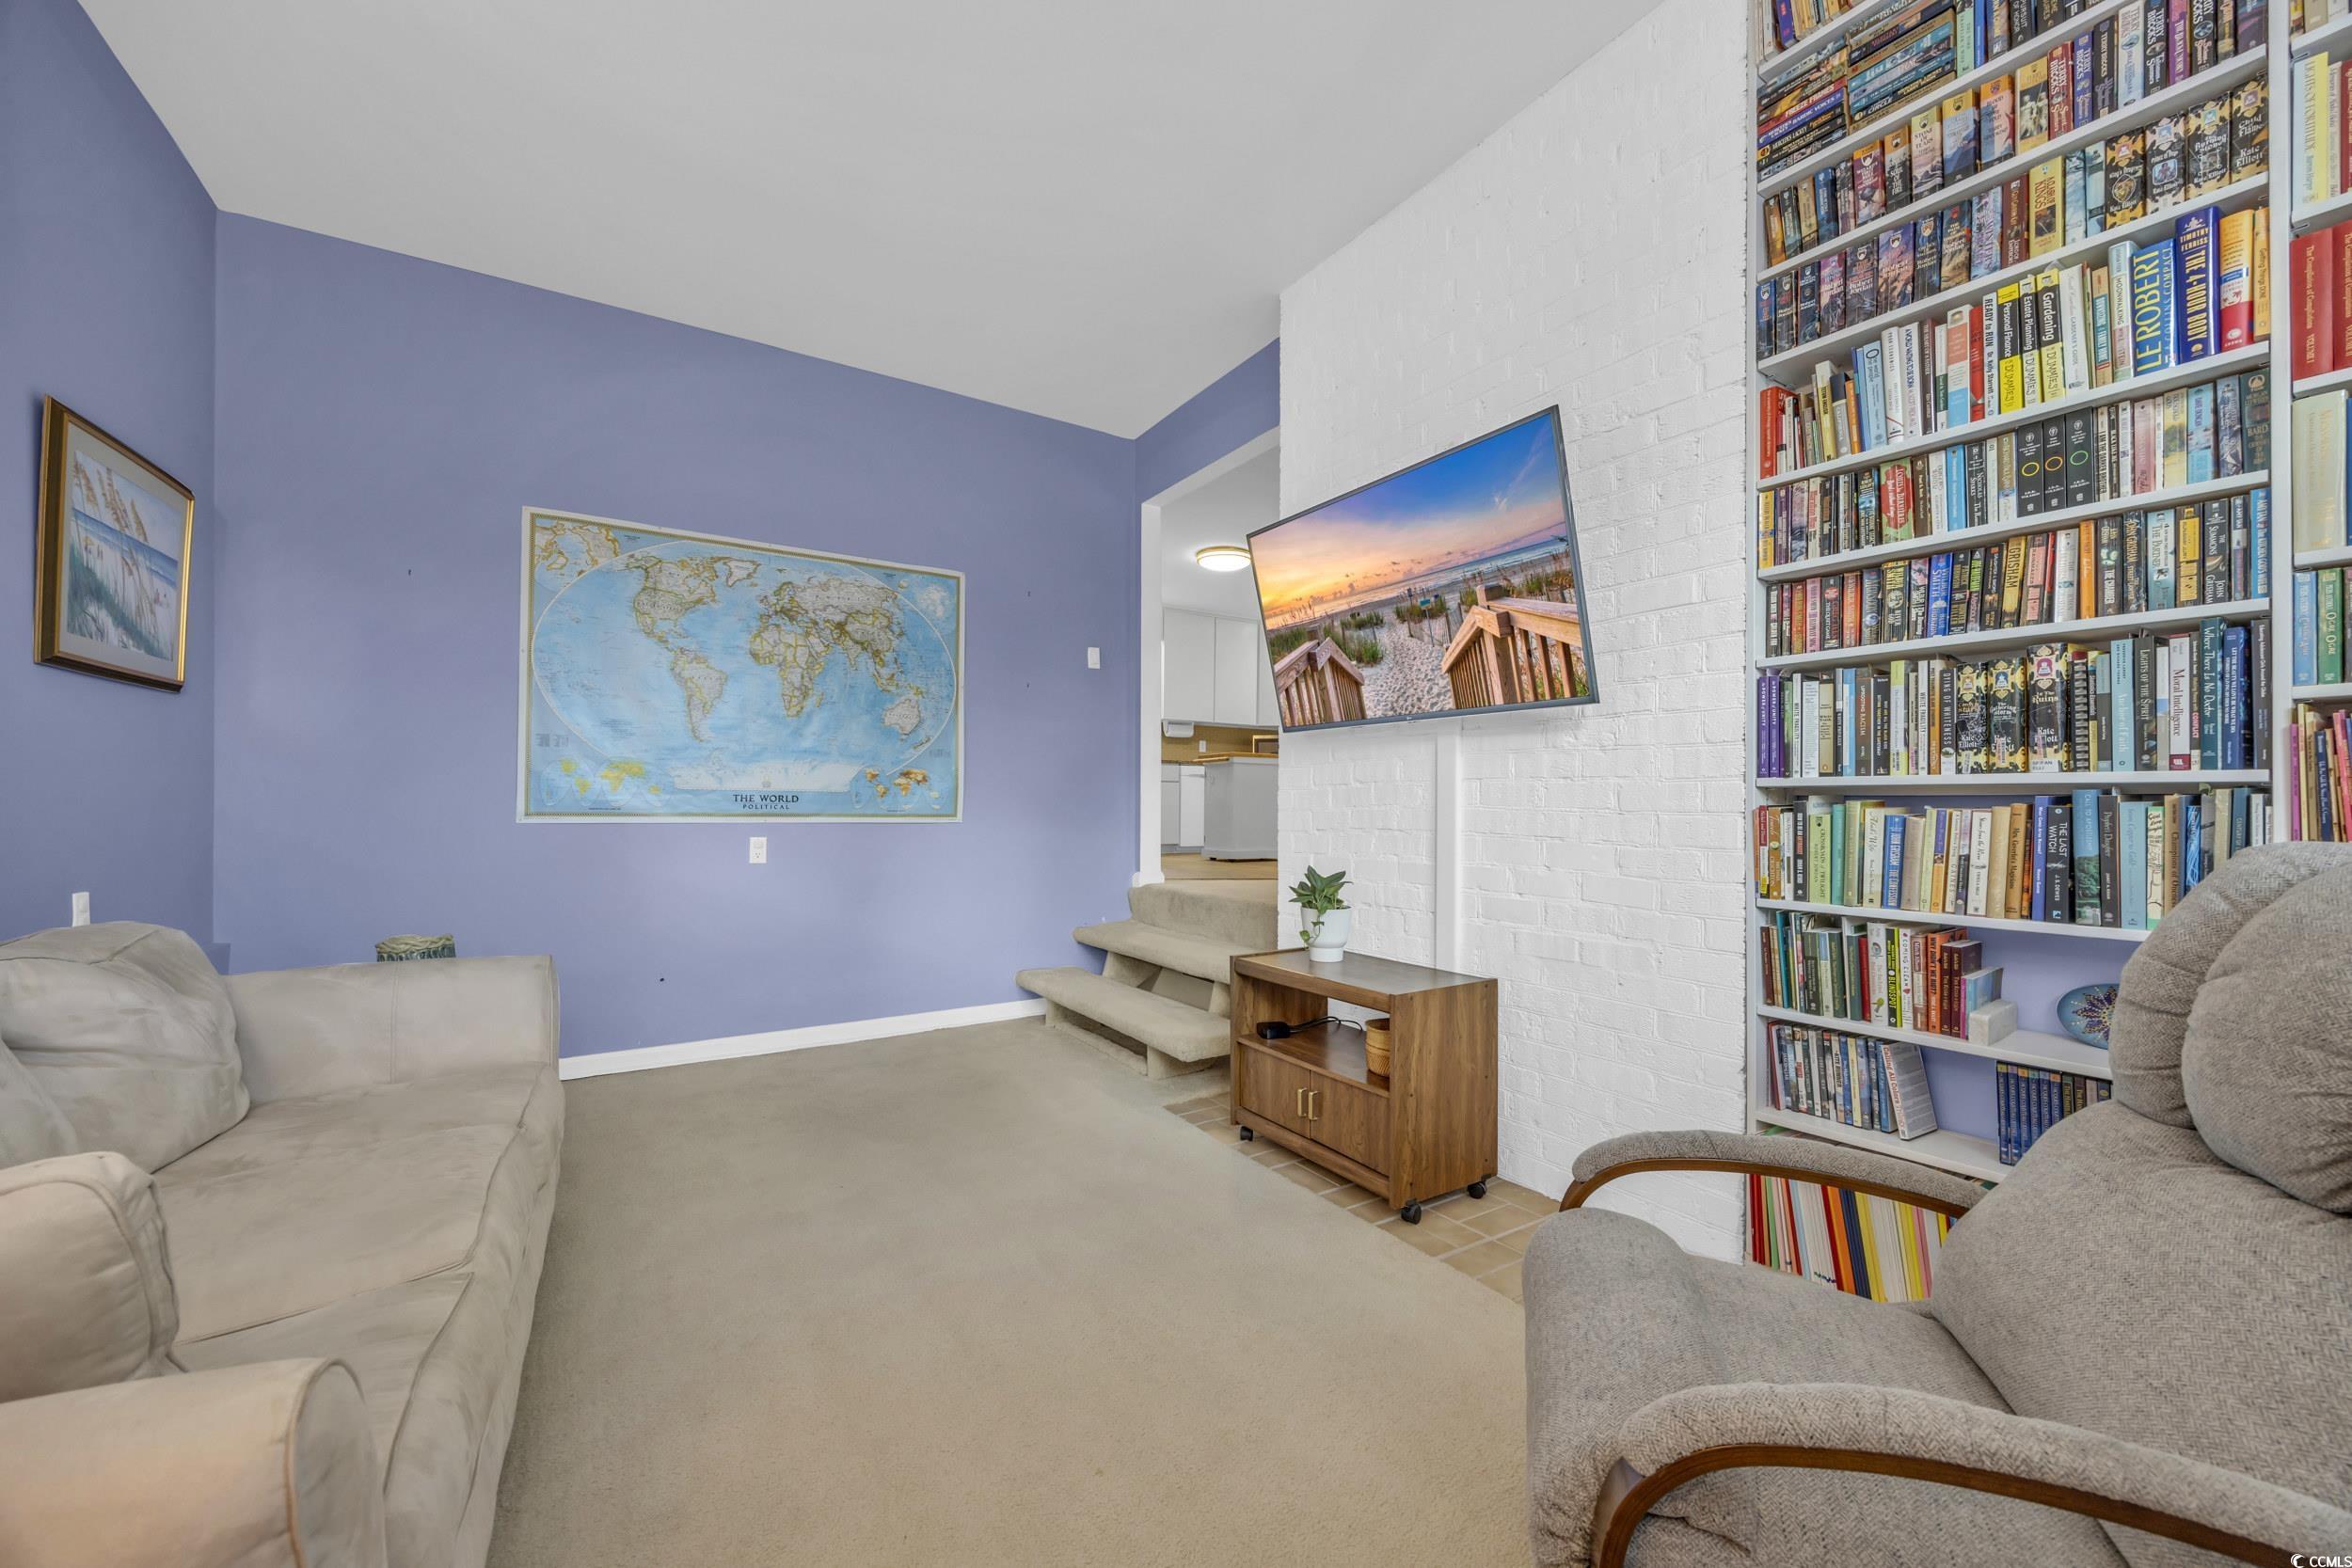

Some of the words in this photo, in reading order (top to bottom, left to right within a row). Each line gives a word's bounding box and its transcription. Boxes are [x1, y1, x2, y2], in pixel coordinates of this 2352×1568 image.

[2147, 9, 2156, 45] BROOKS
[2156, 8, 2165, 38] TERRY
[2050, 59, 2058, 95] BROOKS
[2034, 179, 2047, 210] KINGS
[2181, 236, 2208, 252] FERRISS
[2162, 247, 2172, 294] COMPACT
[2185, 249, 2206, 274] THE
[2024, 295, 2032, 318] Estate
[2115, 277, 2124, 325] MOONWALKING
[2133, 250, 2162, 341] ROBERT
[2185, 274, 2207, 314] 4-HOUR
[1984, 298, 1993, 322] READY
[2004, 302, 2012, 332] Personal
[2042, 292, 2056, 341] Gardening
[1985, 331, 1994, 347] RUN
[2024, 319, 2034, 351] Planning
[2186, 312, 2208, 341] BODY
[2004, 331, 2014, 357] Finance
[2136, 341, 2162, 372] LE
[2004, 362, 2014, 401] DUMMIES
[2026, 357, 2037, 395] DUMMIES
[2045, 351, 2058, 389] DUMMIES
[2099, 434, 2107, 443] AM
[2099, 442, 2107, 452] THE
[2099, 451, 2107, 471] DARKER
[2099, 471, 2107, 495] BROTHER
[2126, 536, 2137, 562] GRISHAM
[2208, 525, 2219, 556] SUMMONS
[2006, 546, 2021, 589] GRISHAM
[2152, 540, 2165, 569] PARTNER
[1931, 569, 1941, 597] SMITH
[2104, 569, 2114, 579] THE
[1865, 579, 1880, 613] MONSOON
[2104, 579, 2115, 604] CHAMBER
[2205, 575, 2216, 604] GRISHAM
[2216, 579, 2226, 597] JOHN
[2203, 626, 2216, 650] Where
[2139, 649, 2152, 673] LIGHTS
[2203, 651, 2216, 671] There
[1943, 673, 1951, 692] DYING
[2139, 673, 2152, 684] OF
[2172, 669, 2185, 693] Moral
[2203, 672, 2216, 680] Is
[2203, 683, 2216, 693] No
[1943, 695, 1951, 704] OF
[2139, 684, 2152, 698] THE
[2139, 698, 2152, 721] SPIRIT
[2167, 694, 2184, 736] Intelligence
[2203, 695, 2216, 718] Doctor
[1943, 706, 1951, 745] WHITENESS
[733, 794, 756, 802] THE
[759, 794, 799, 803] WORLD
[2048, 825, 2057, 853] WATCH
[2169, 832, 2180, 869] Champions
[2009, 864, 2018, 890] Magicians
[2171, 870, 2179, 879] of
[1888, 976, 1897, 1009] BLINDSPOT
[1883, 1047, 1894, 1070] Calling
[1891, 1082, 1899, 1104] Colors
